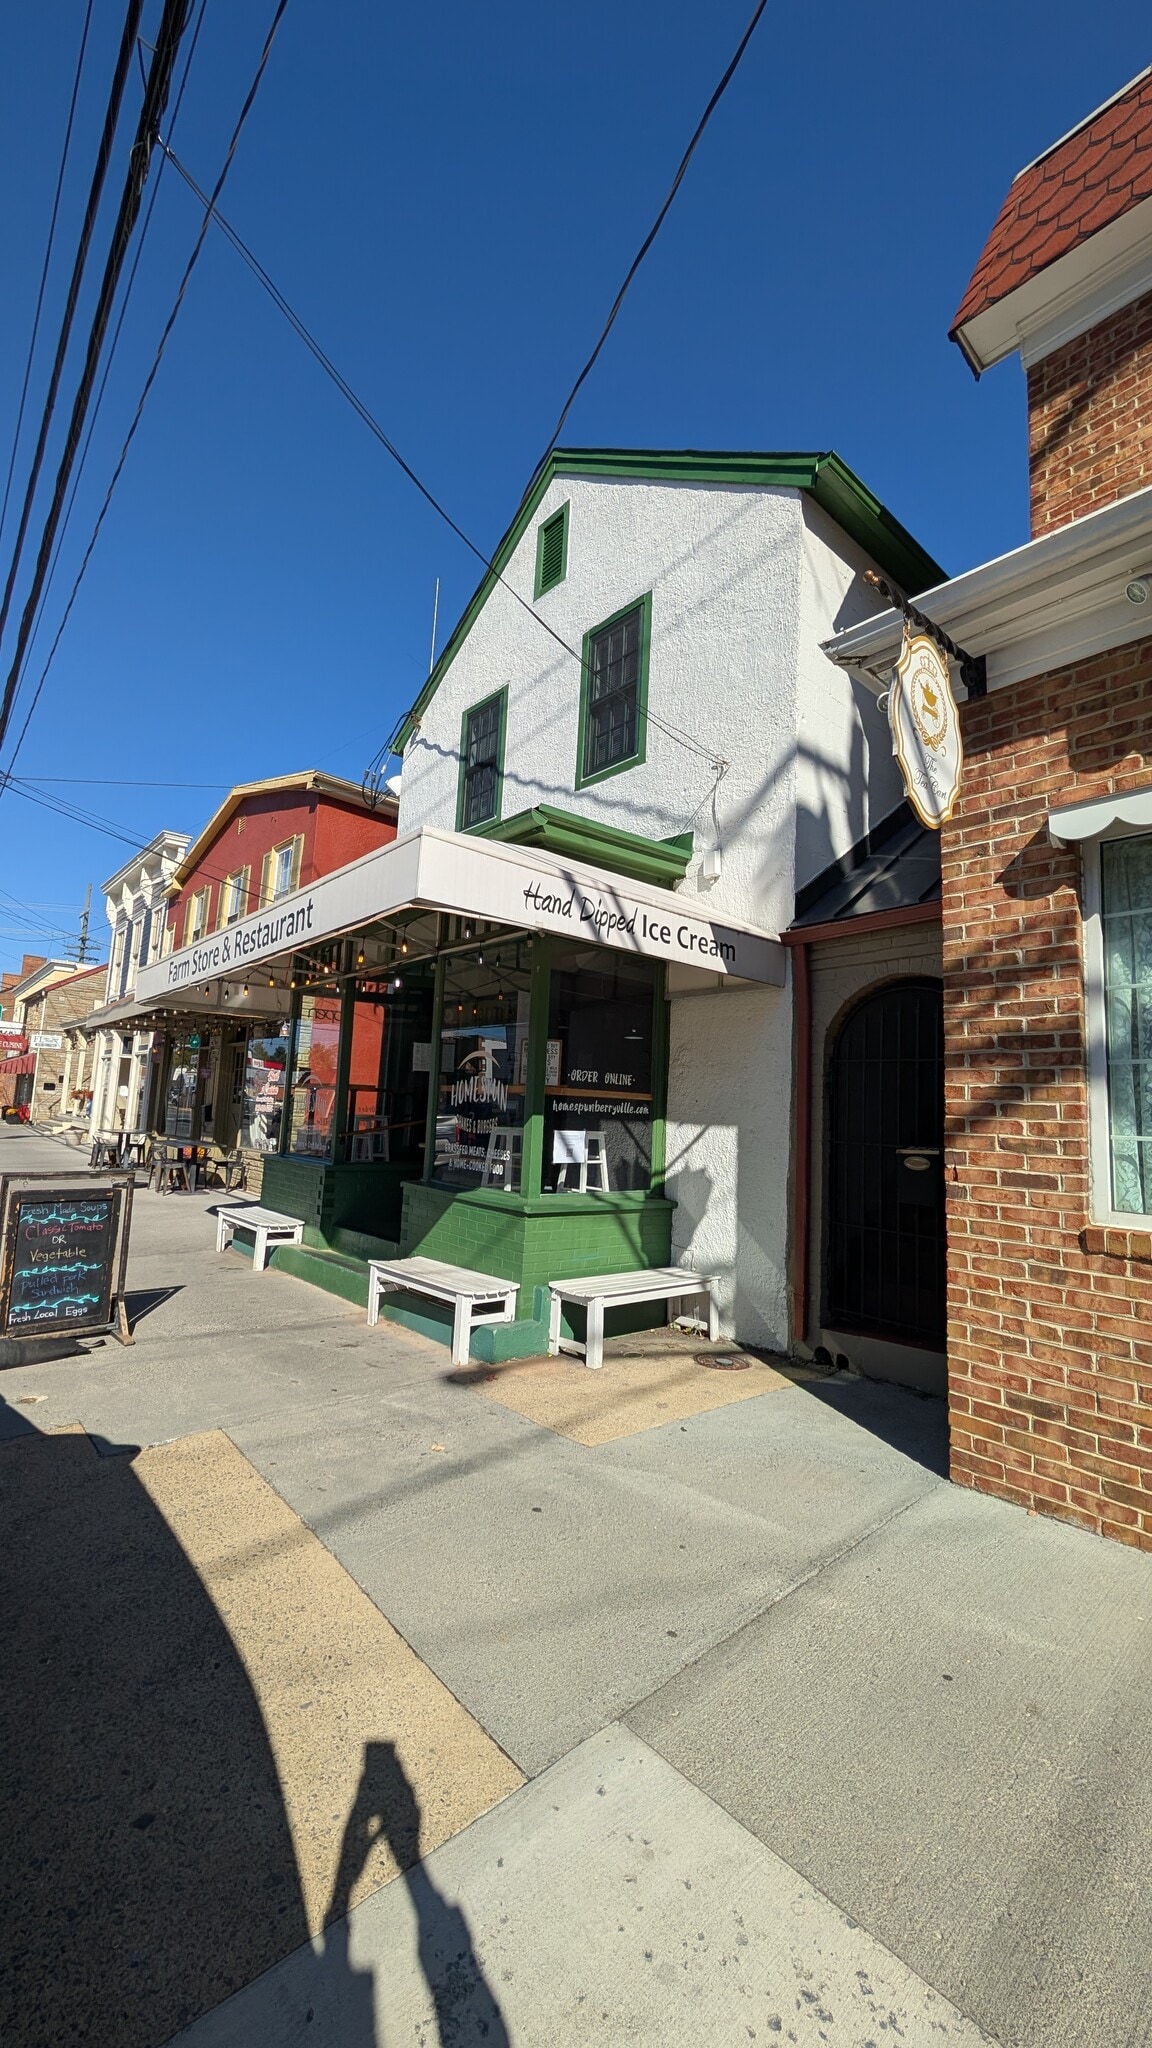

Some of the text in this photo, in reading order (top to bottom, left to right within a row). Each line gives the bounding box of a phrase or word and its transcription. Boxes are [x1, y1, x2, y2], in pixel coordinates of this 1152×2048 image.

[925, 753, 938, 774] The
[914, 768, 948, 800] Tea Cart
[523, 880, 736, 962] Hand Dipped Ice Cream
[168, 897, 314, 985] Farm Store & Restaurant
[570, 1069, 599, 1083] ORDER
[604, 1072, 633, 1086] ONLINE
[450, 1076, 509, 1112] HOMESPUN
[552, 1100, 650, 1115] homespunberryville.com
[490, 1163, 504, 1176] FOOD
[20, 1201, 108, 1216] Fresh Made Soups
[25, 1222, 104, 1240] Classic Tomato
[52, 1234, 67, 1244] OR
[30, 1247, 87, 1263] Vegetable
[8, 1306, 88, 1325] Fresh Local Eggs
